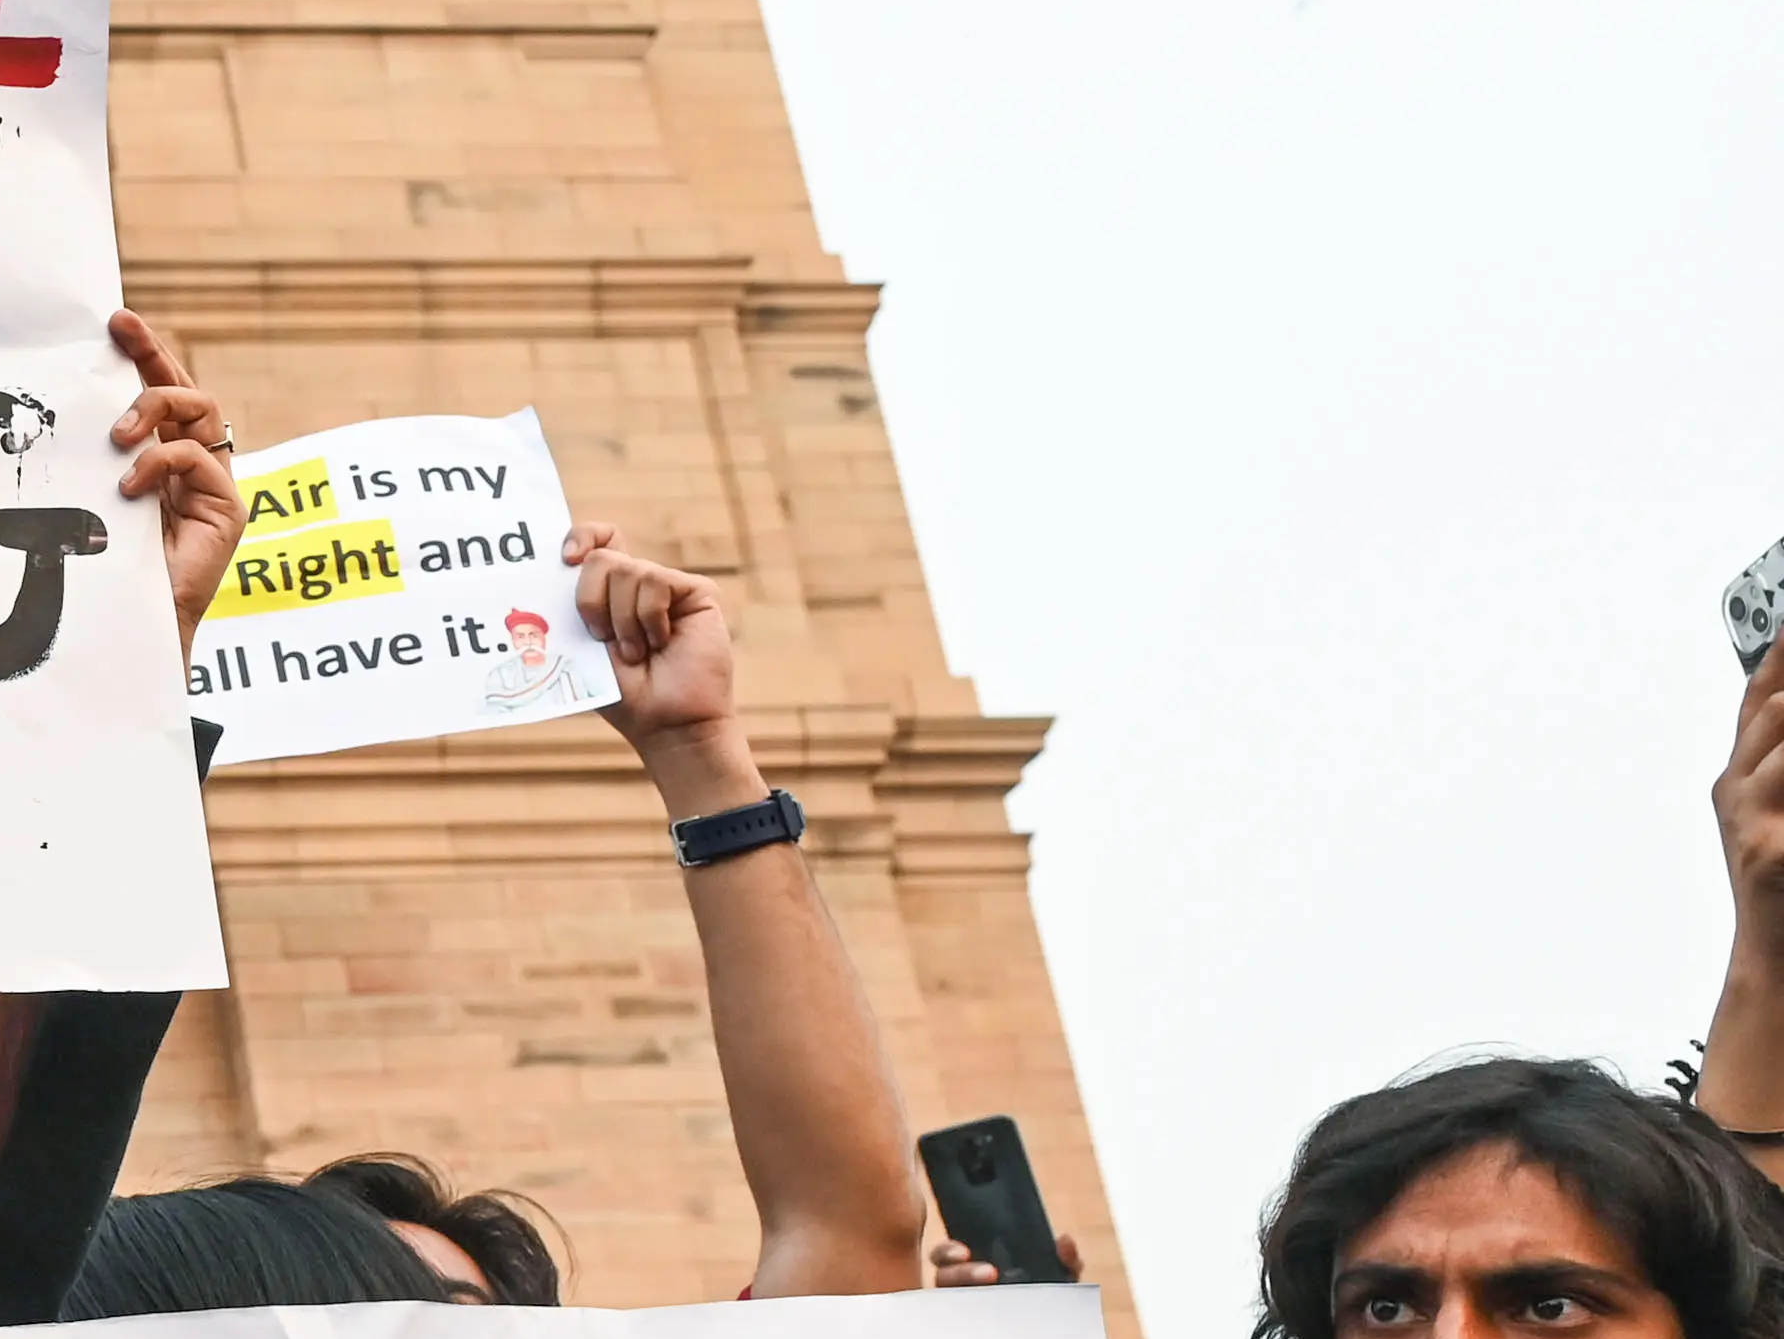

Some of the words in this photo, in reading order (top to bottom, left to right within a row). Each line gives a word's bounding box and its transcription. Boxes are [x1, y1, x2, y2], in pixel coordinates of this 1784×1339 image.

[247, 479, 331, 523] Air
[349, 463, 398, 501] is
[418, 464, 508, 499] my
[235, 539, 400, 600] Right
[418, 521, 536, 573] and
[273, 631, 424, 684] have
[441, 613, 510, 658] it.
